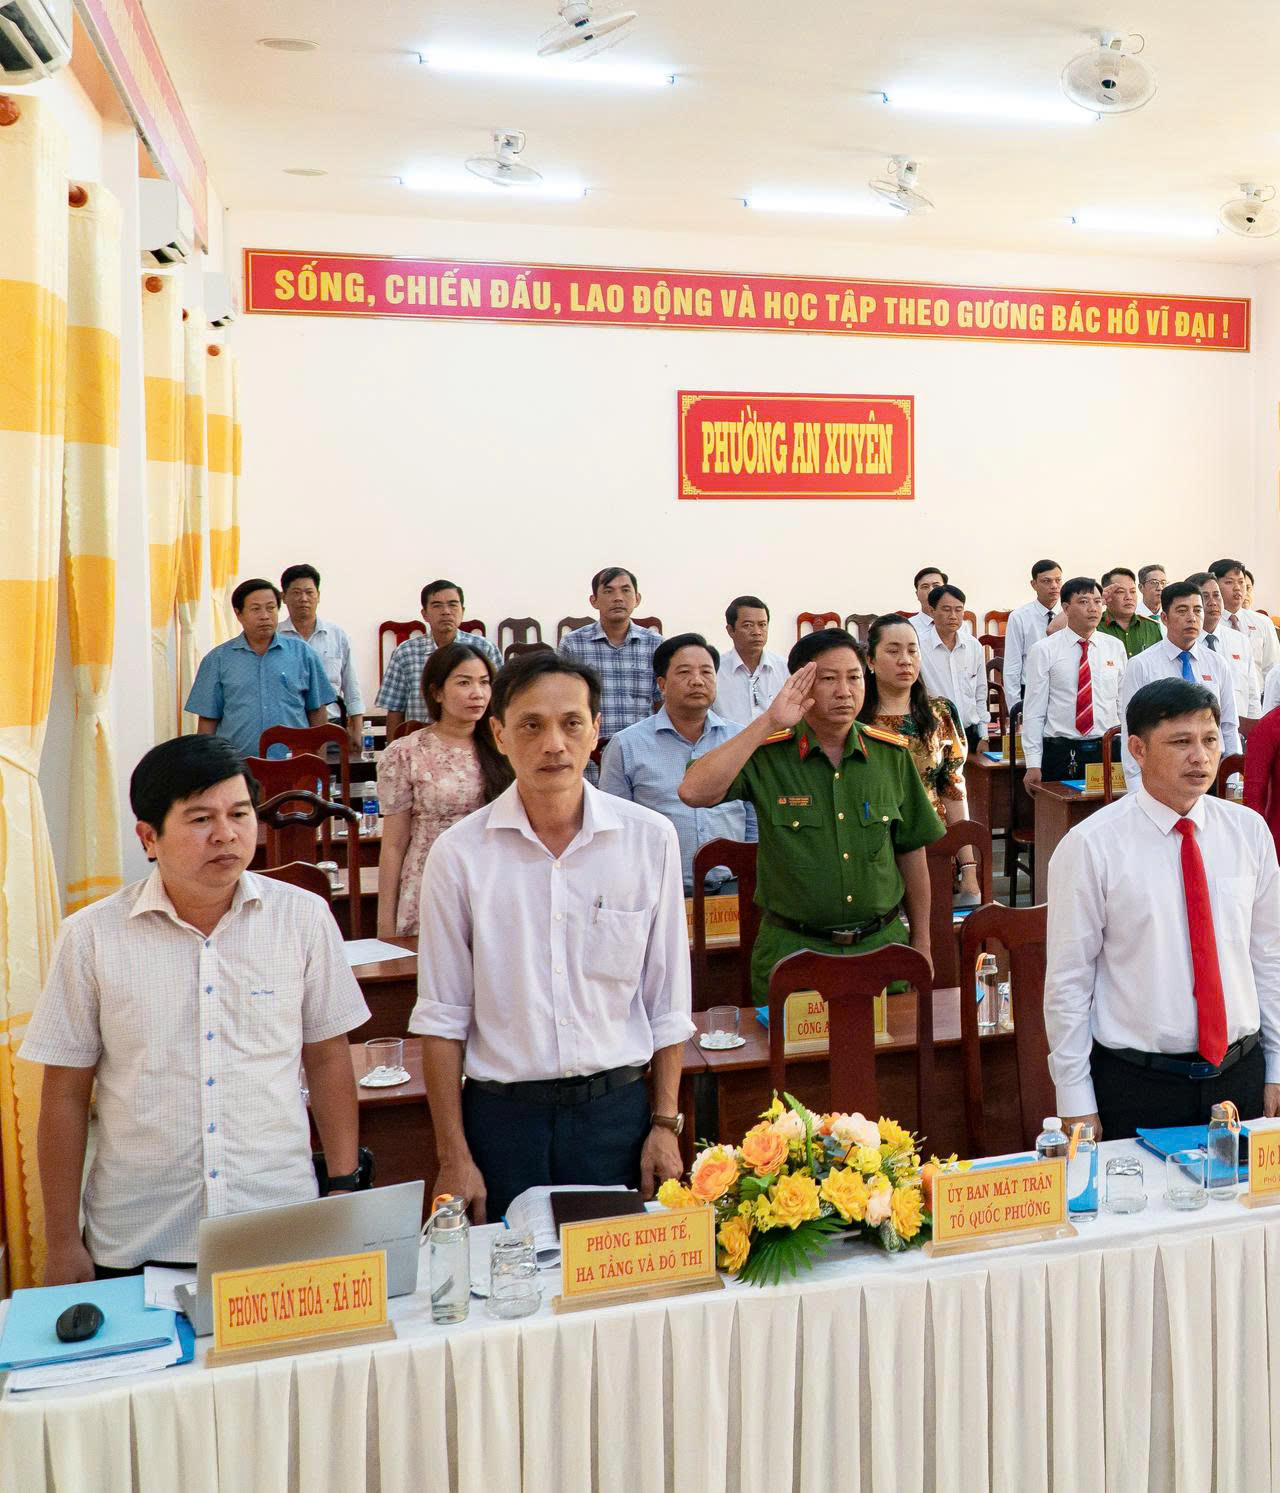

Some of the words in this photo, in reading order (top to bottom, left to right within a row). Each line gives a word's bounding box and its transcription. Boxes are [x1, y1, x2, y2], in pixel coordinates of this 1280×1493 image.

[275, 261, 375, 307] SỐNG,
[385, 268, 481, 308] CHIẾN
[490, 270, 561, 315] ĐẤU,
[571, 284, 624, 313] LAO
[633, 280, 712, 320] ĐỘNG
[721, 283, 757, 318] VÀ
[765, 293, 818, 327] HỌC
[825, 289, 876, 328] TẬP
[883, 296, 949, 327] THEO
[957, 300, 1045, 330] GƯƠNG
[1052, 300, 1101, 333] BÁC
[1108, 299, 1140, 335] HỒ
[1146, 304, 1169, 336] VĨ
[1175, 311, 1215, 343] ĐẠI
[1221, 313, 1230, 339] !
[701, 404, 788, 475] PHƯỜNG
[791, 421, 821, 474] AN
[824, 410, 893, 475] XUYÊN
[807, 1001, 824, 1015] BAN
[797, 1019, 821, 1035] CÔNG
[1258, 1145, 1275, 1170] Đ/c
[947, 1183, 963, 1203] ỦY
[967, 1183, 989, 1201] BAN
[993, 1177, 1018, 1199] MẶT
[1022, 1172, 1053, 1193] TRẬN
[950, 1204, 965, 1229] TỔ
[969, 1202, 1001, 1229] QUỐC
[1005, 1199, 1051, 1221] PHƯỜNG
[586, 1231, 630, 1252] PHÒNG
[635, 1227, 667, 1246] KINH
[671, 1216, 691, 1241] TẾ,
[576, 1266, 594, 1284] HẠ
[599, 1254, 633, 1279] TẦNG
[638, 1253, 654, 1273] VÀ
[659, 1249, 676, 1270] ĐÔ
[681, 1249, 703, 1267] THỊ
[228, 1288, 268, 1328] PHÒNG
[271, 1282, 295, 1321] VĂN
[298, 1276, 323, 1317] HÓA
[333, 1272, 350, 1312] XÃ
[352, 1269, 373, 1316] HỘI
